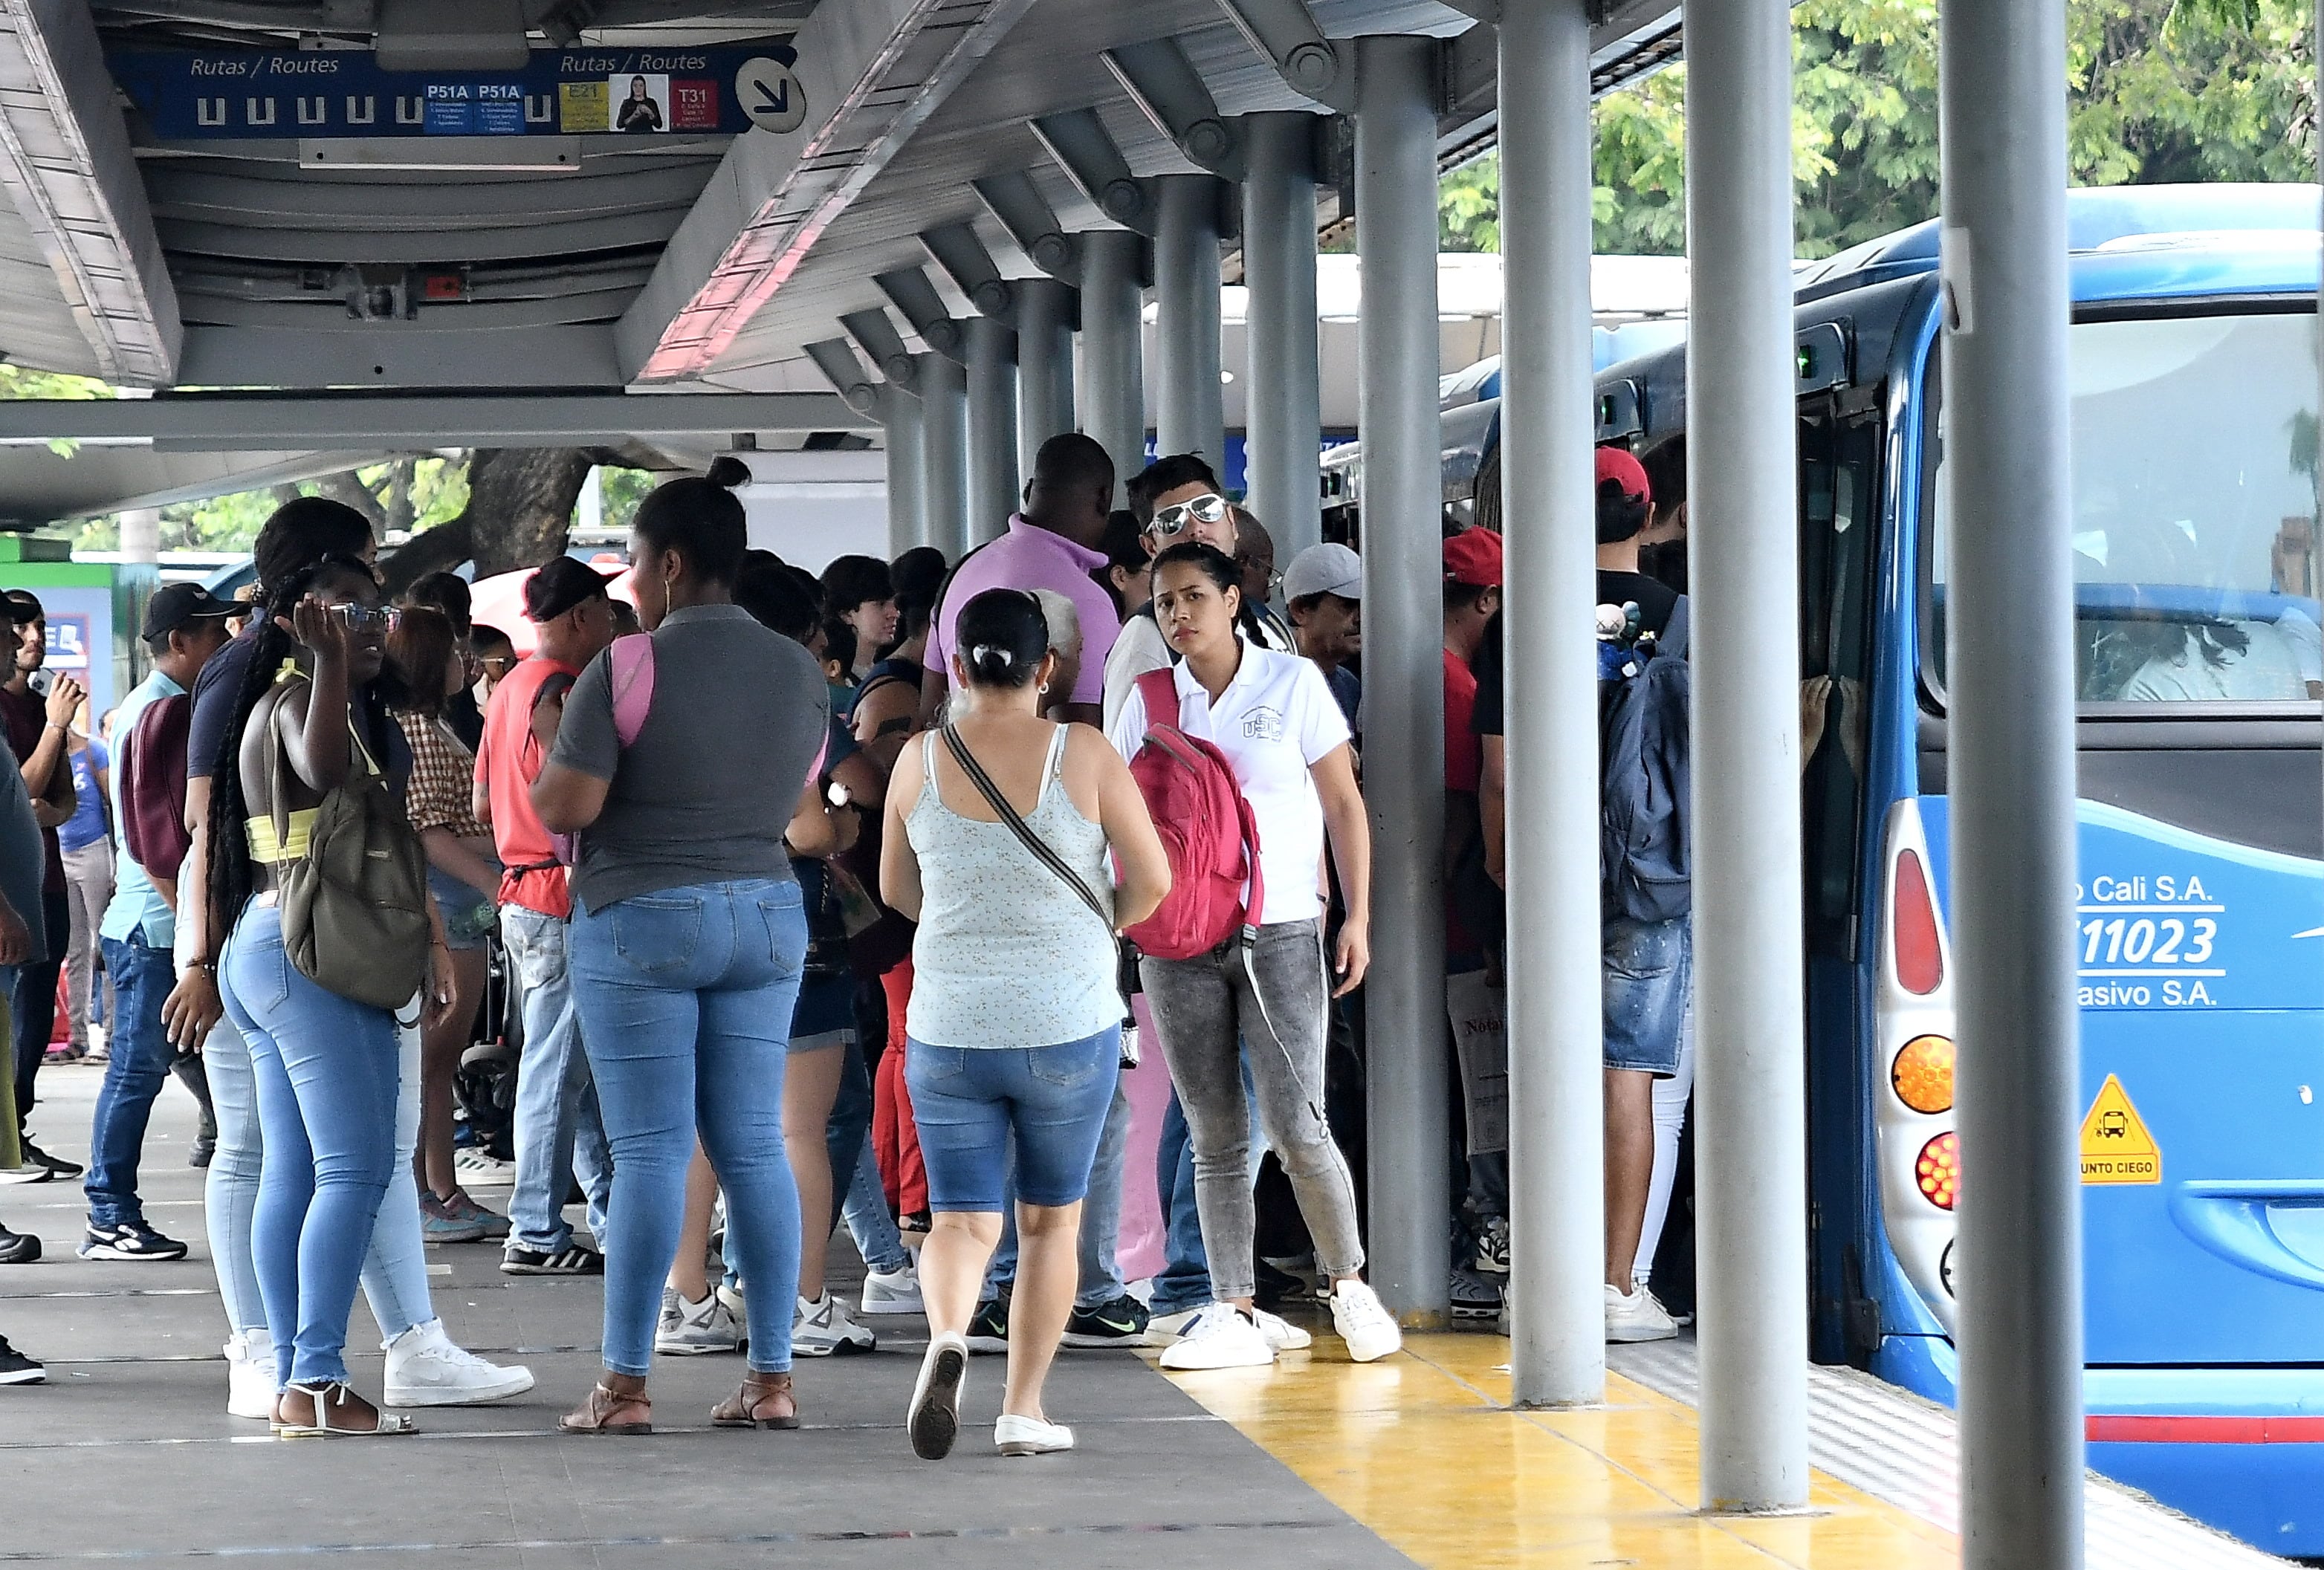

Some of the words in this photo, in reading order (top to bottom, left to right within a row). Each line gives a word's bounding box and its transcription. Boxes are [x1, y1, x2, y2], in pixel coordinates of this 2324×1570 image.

[190, 57, 246, 76] Rutas
[269, 56, 338, 75] Routes
[560, 56, 615, 72] Rutas
[638, 54, 706, 71] Routes
[427, 85, 468, 98] P51A
[479, 85, 519, 98] P51A
[678, 88, 705, 103] T31
[1243, 713, 1281, 738] USC
[2092, 875, 2146, 901] Cali
[2155, 875, 2213, 901] S.A.
[2076, 918, 2217, 963] 11023
[2162, 979, 2217, 1005] S.A.
[2117, 1162, 2152, 1173] CIEGO
